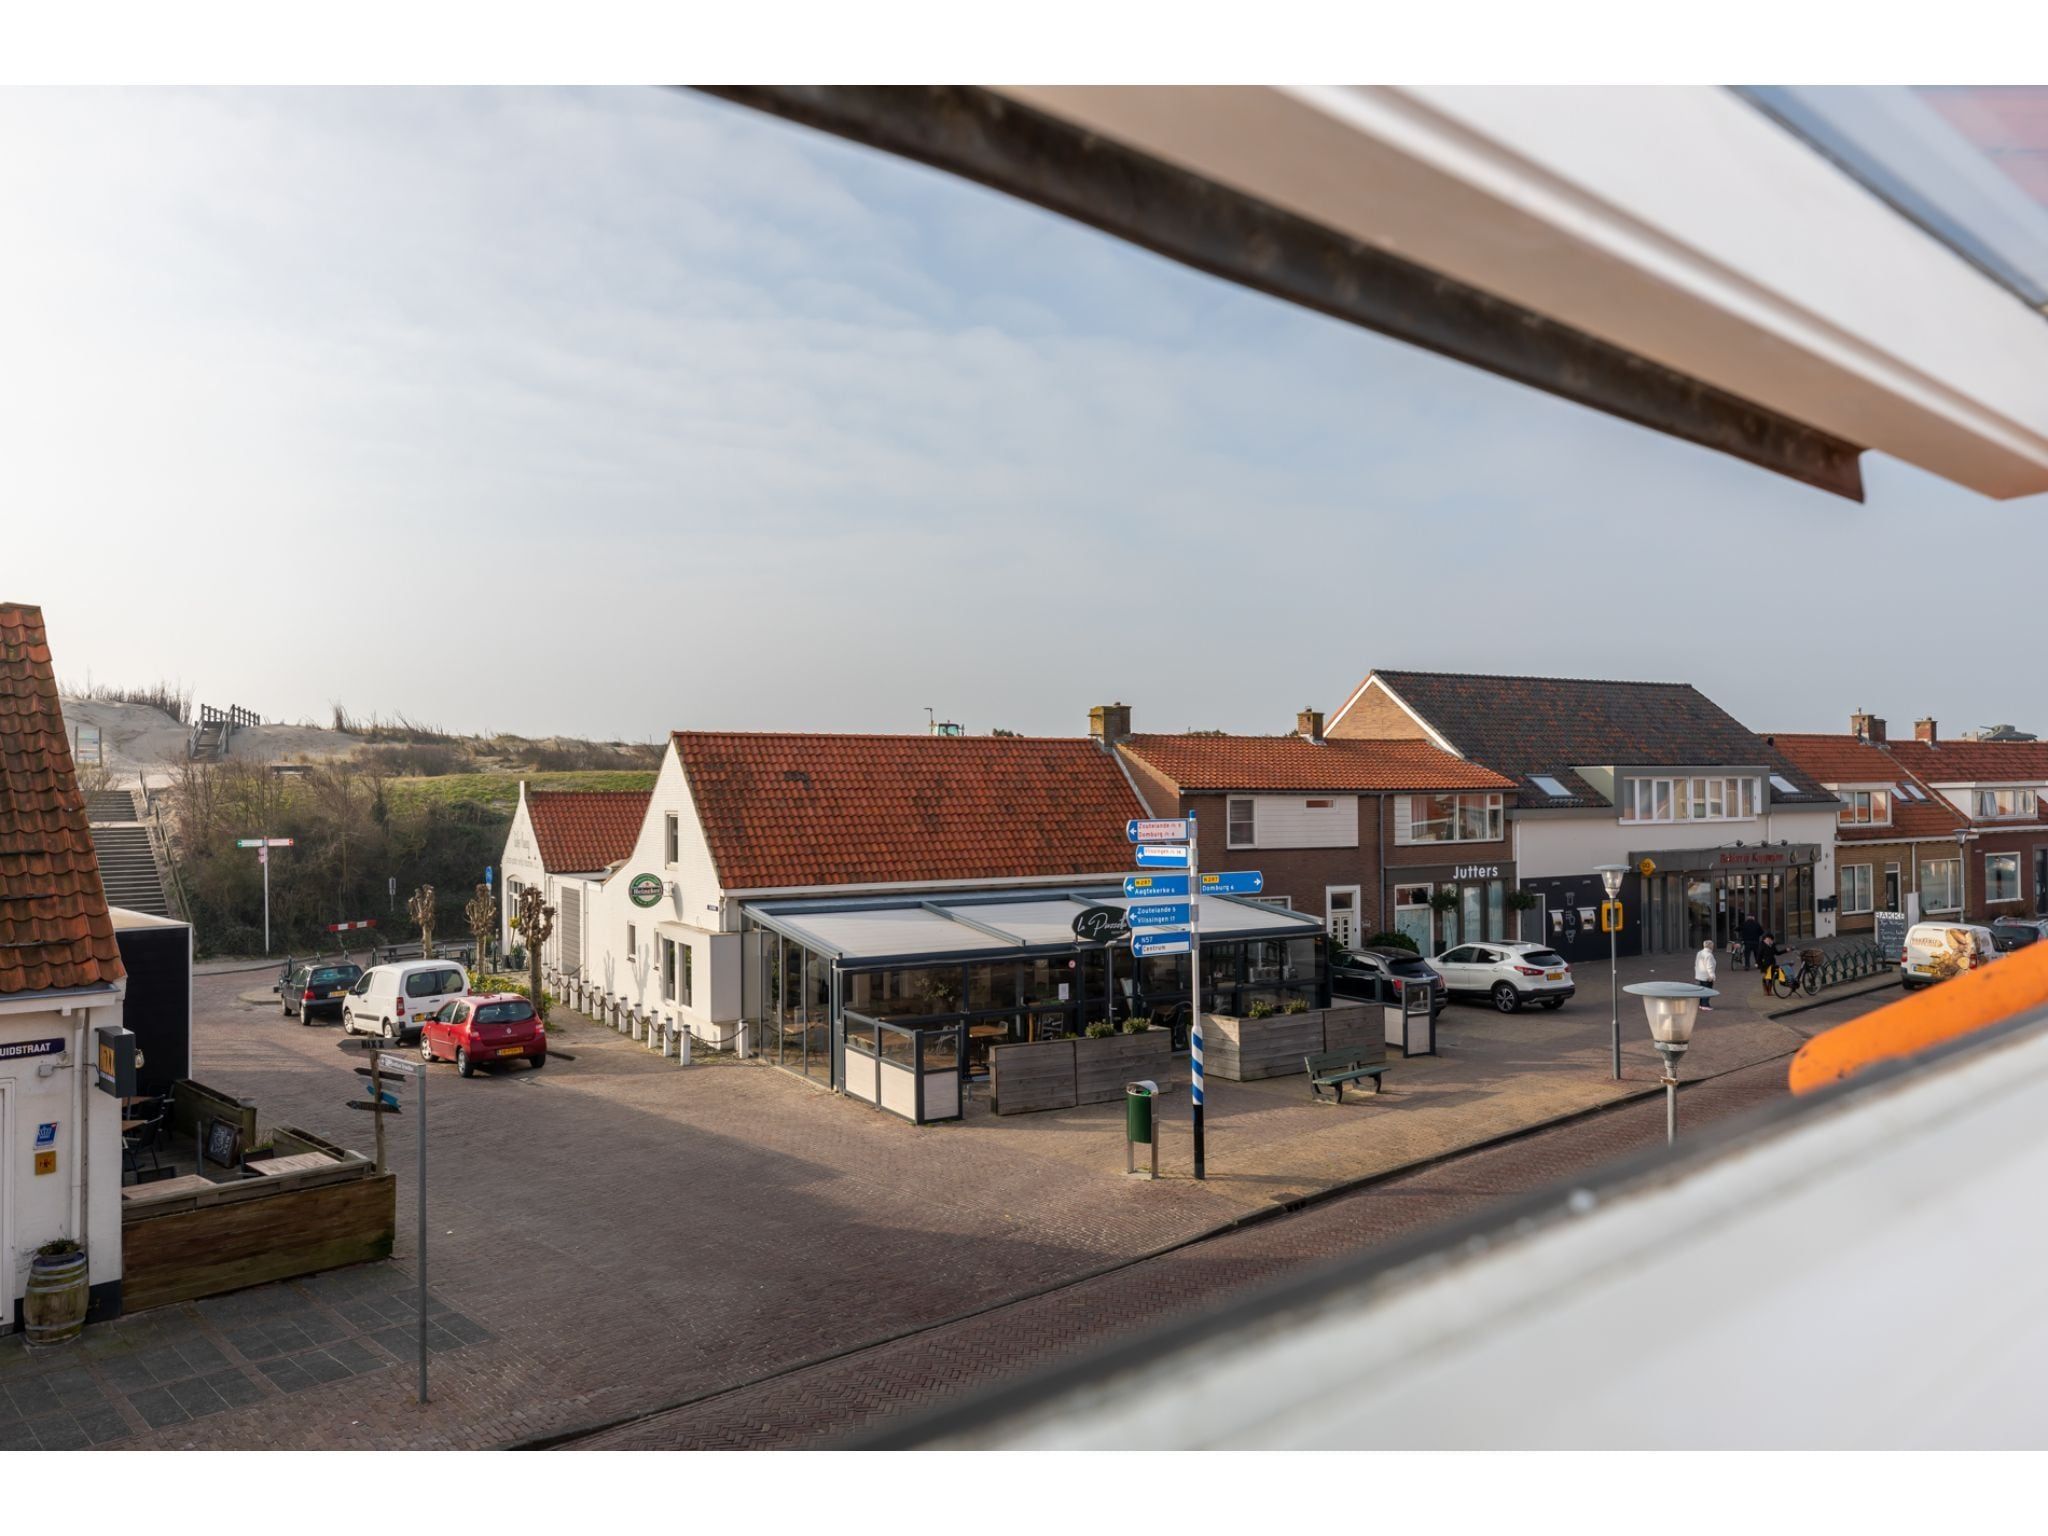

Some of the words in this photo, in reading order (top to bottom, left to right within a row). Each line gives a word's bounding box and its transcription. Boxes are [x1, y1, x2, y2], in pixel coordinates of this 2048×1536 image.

[1138, 831, 1163, 839] Domburg
[1453, 865, 1499, 880] Jutters
[1134, 887, 1170, 896] Aagtekerke
[1202, 884, 1230, 892] Domburg
[1137, 906, 1171, 915] Zoutelande
[1137, 916, 1169, 925] Vlissingen
[1141, 936, 1153, 944] N57
[1143, 944, 1166, 953] Centrum
